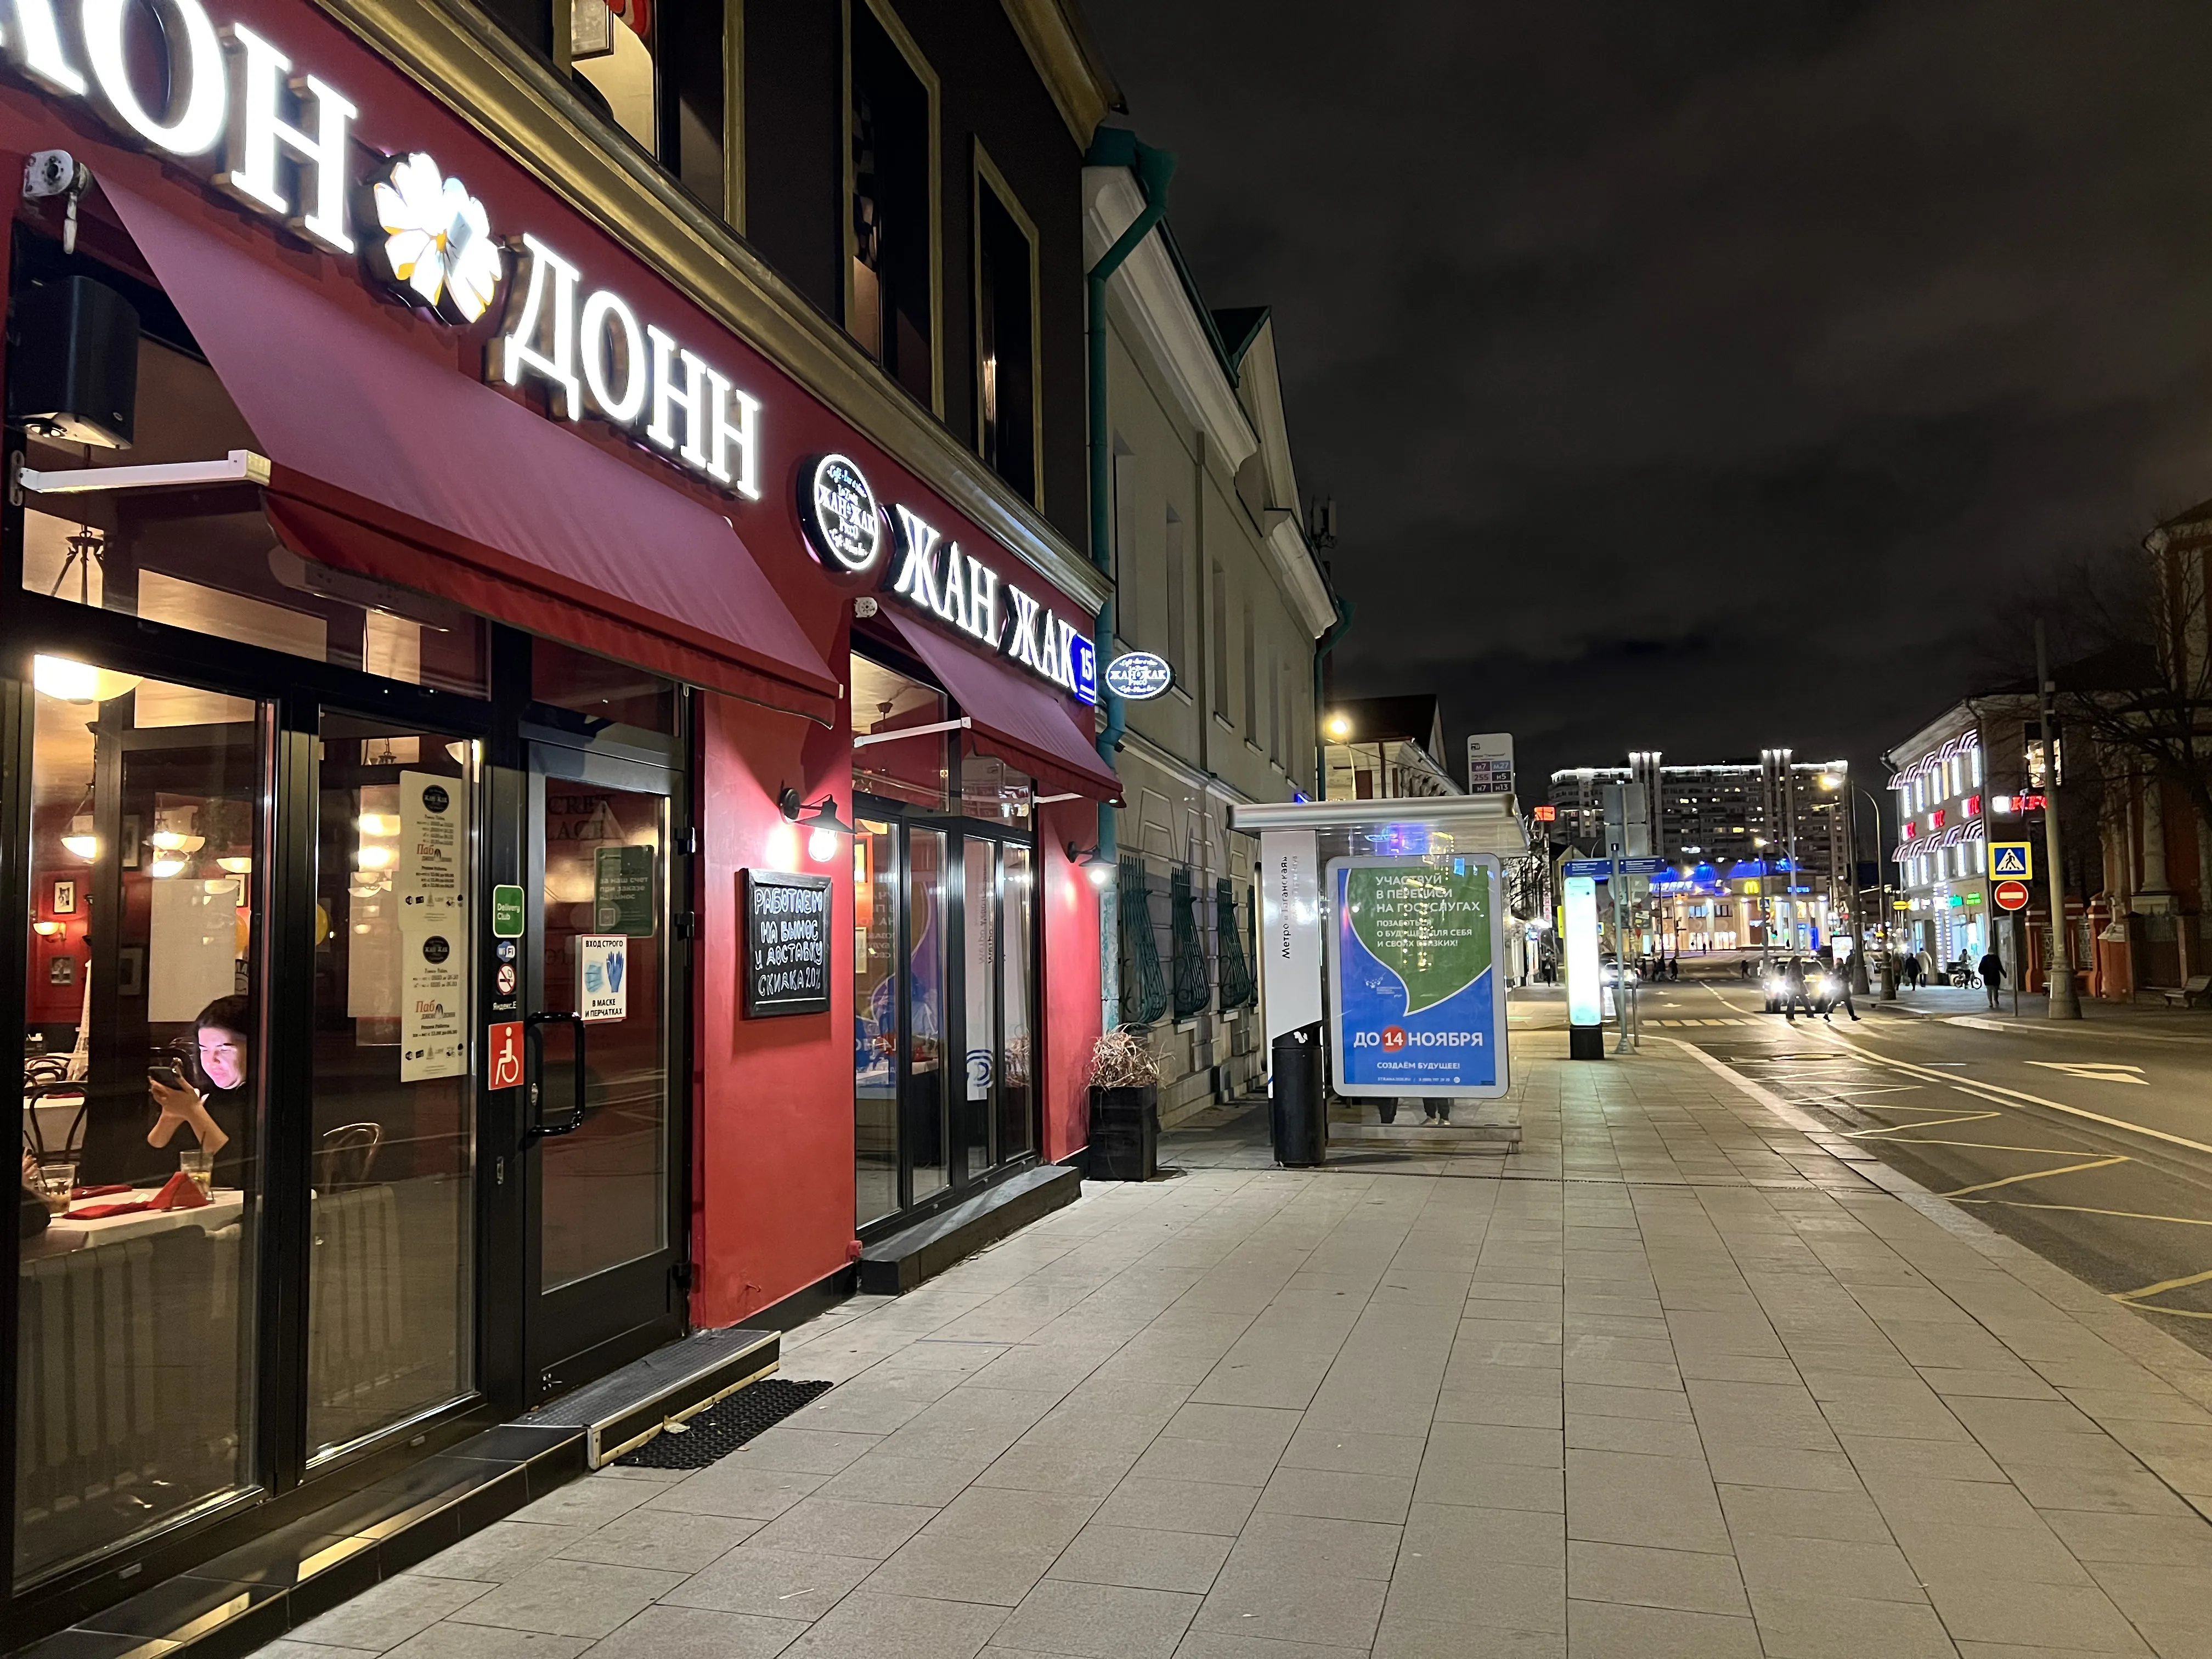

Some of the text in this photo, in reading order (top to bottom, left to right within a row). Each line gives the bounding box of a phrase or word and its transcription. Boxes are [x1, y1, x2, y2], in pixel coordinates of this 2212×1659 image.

[504, 233, 760, 500] ДОНН
[819, 484, 847, 519] ЖАН
[894, 502, 1078, 693] ЖАН ЖАК
[1080, 647, 1093, 681] 15
[417, 844, 435, 855] Паб
[1375, 873, 1442, 885] УЧАСТВУЙ
[754, 887, 823, 915] РАБОТАЕМ
[1376, 889, 1453, 899] В ПЕРЕПИСИ
[498, 903, 520, 913] Delivery
[1376, 904, 1394, 912] НА
[760, 919, 819, 944] НА ВЫНОС
[586, 940, 601, 949] ВХОД
[1282, 923, 1291, 959] Метро
[766, 940, 823, 966] ДОСТАВКУ
[758, 967, 821, 996] СКИДКА 20%
[415, 999, 435, 1013] Паб
[590, 1008, 622, 1017] ПЕРЧАТКАХ
[1353, 1032, 1483, 1048] ДО 14 НОЯБРЯ
[1376, 1061, 1415, 1069] СОЗДАЁМ
